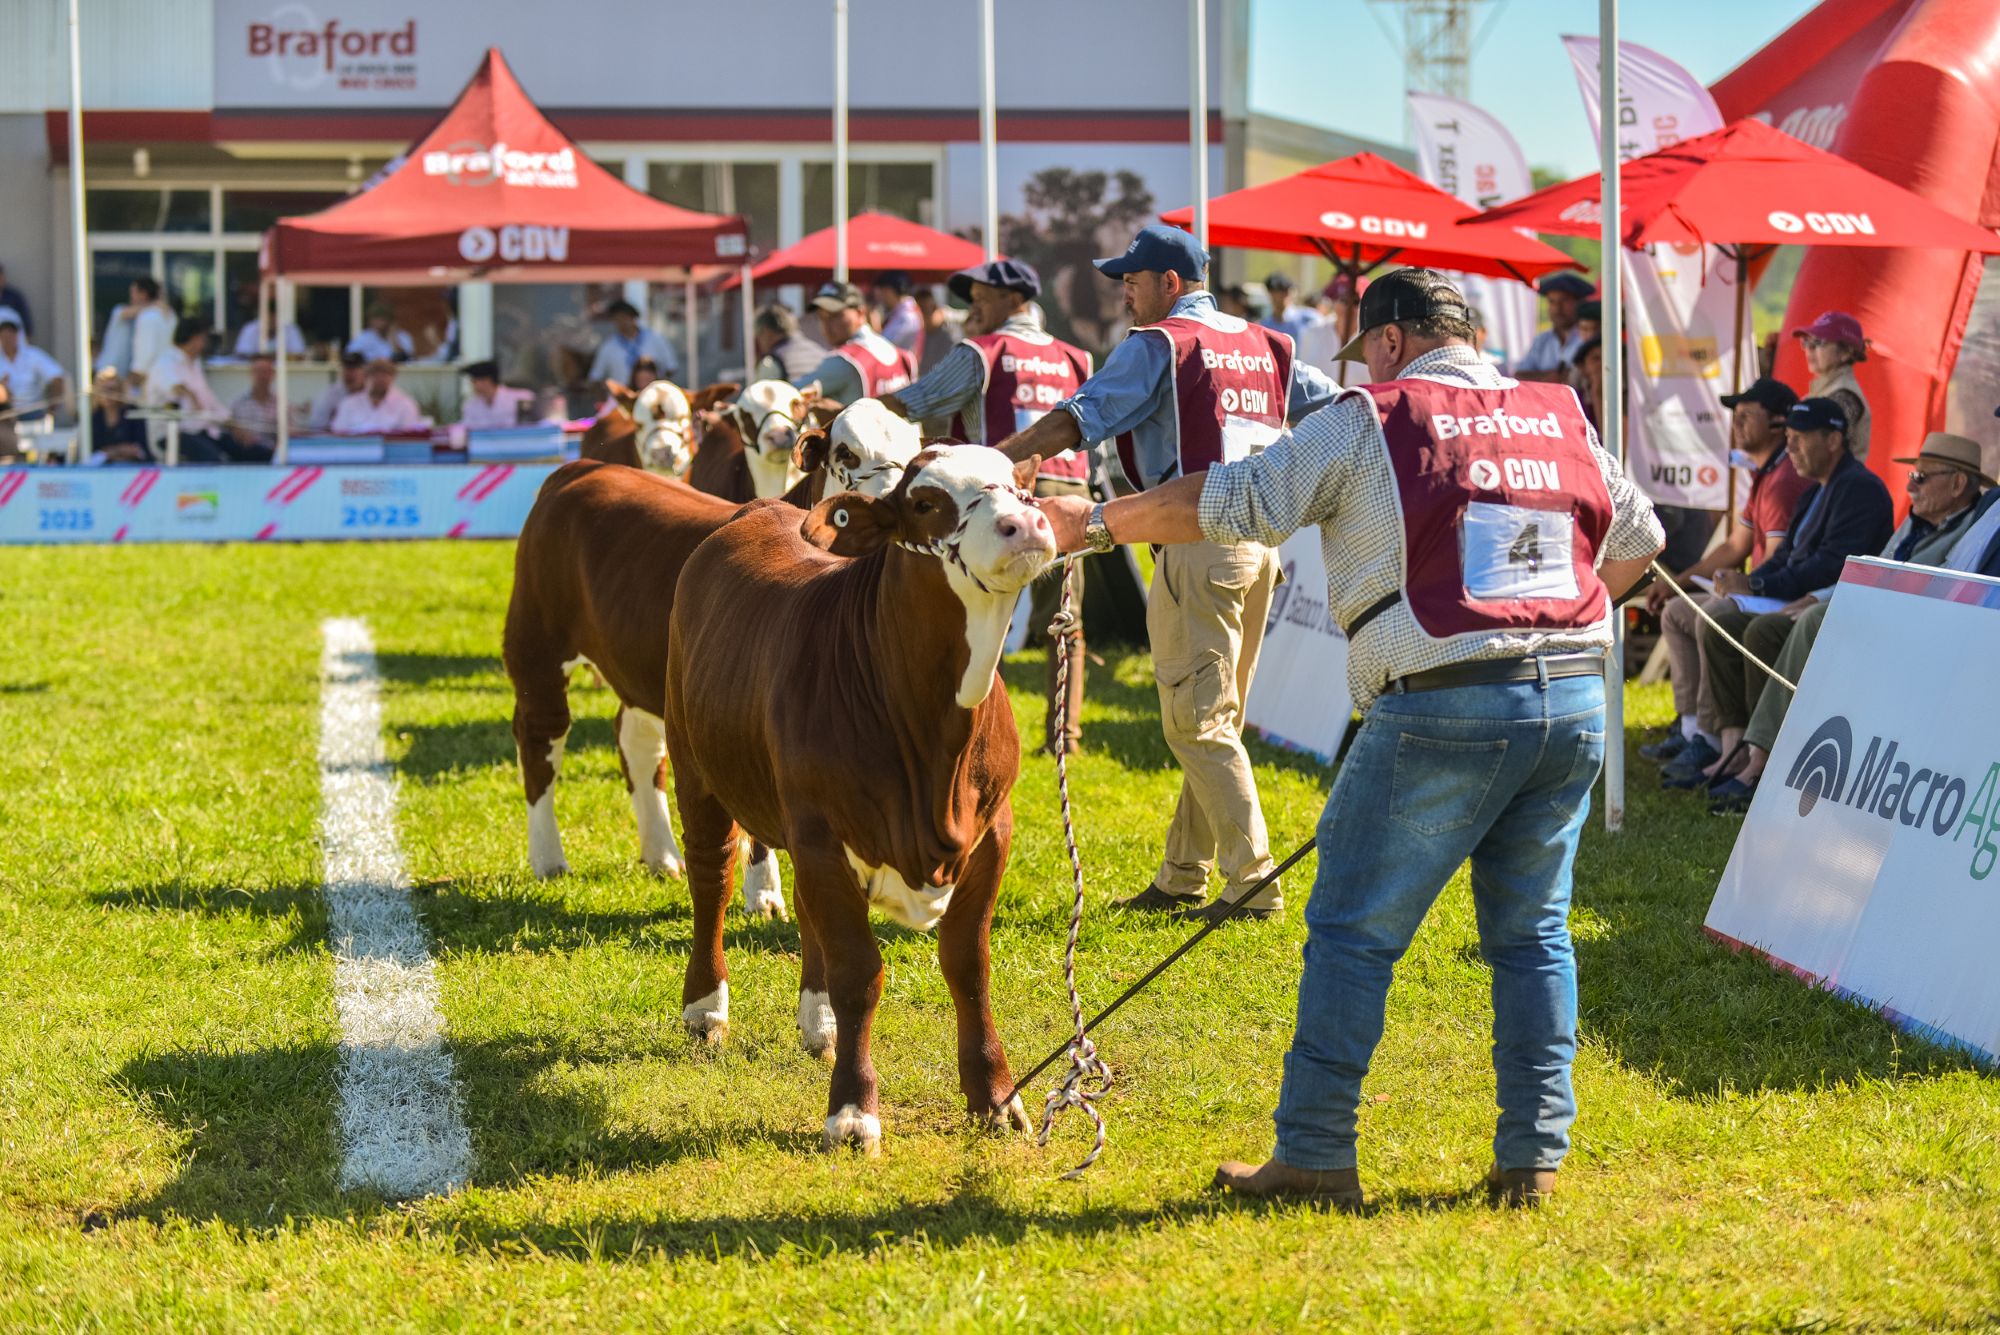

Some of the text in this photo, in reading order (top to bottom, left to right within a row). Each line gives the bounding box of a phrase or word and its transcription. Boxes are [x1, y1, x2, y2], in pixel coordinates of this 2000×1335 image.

[248, 19, 417, 73] Braford
[423, 142, 577, 177] Braford
[1360, 215, 1428, 239] CDV
[1804, 211, 1877, 235] CDV
[499, 224, 570, 261] CDV
[1001, 354, 1070, 378] Braford
[1201, 348, 1274, 374] Braford
[1241, 388, 1268, 414] CDV
[1432, 407, 1564, 441] Braford
[1503, 457, 1561, 491] CDV
[38, 507, 93, 531] 2025
[342, 504, 421, 528] 2025
[1508, 522, 1543, 576] 4
